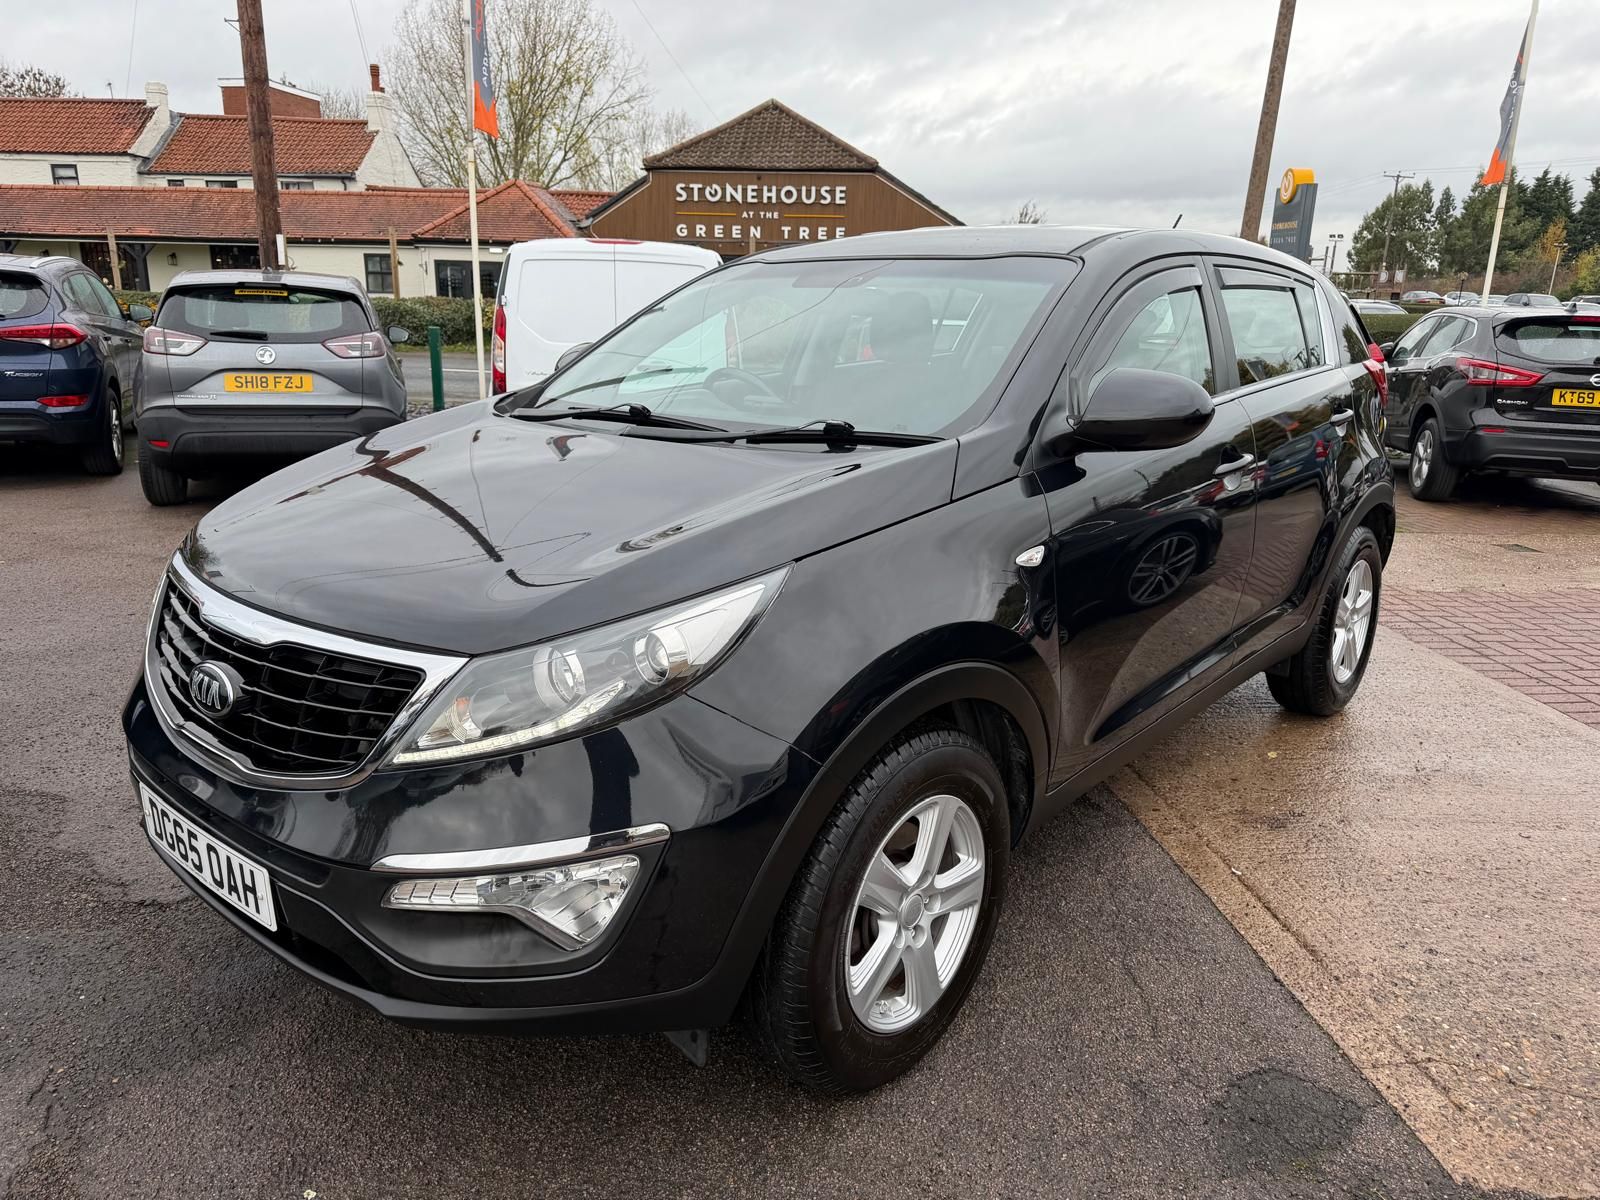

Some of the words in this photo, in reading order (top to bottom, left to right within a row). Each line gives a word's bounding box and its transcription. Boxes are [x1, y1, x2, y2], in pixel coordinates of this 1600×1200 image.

[675, 182, 847, 205] STONEHOUSE
[741, 211, 754, 219] AT
[759, 211, 779, 219] THE
[676, 224, 762, 239] GREEN
[781, 226, 846, 240] TREE
[234, 375, 269, 389] SH18
[273, 375, 304, 389] FZJ
[1558, 390, 1595, 404] KT69
[191, 670, 221, 710] KIA
[148, 796, 204, 875] DG65
[206, 843, 261, 915] OAH
